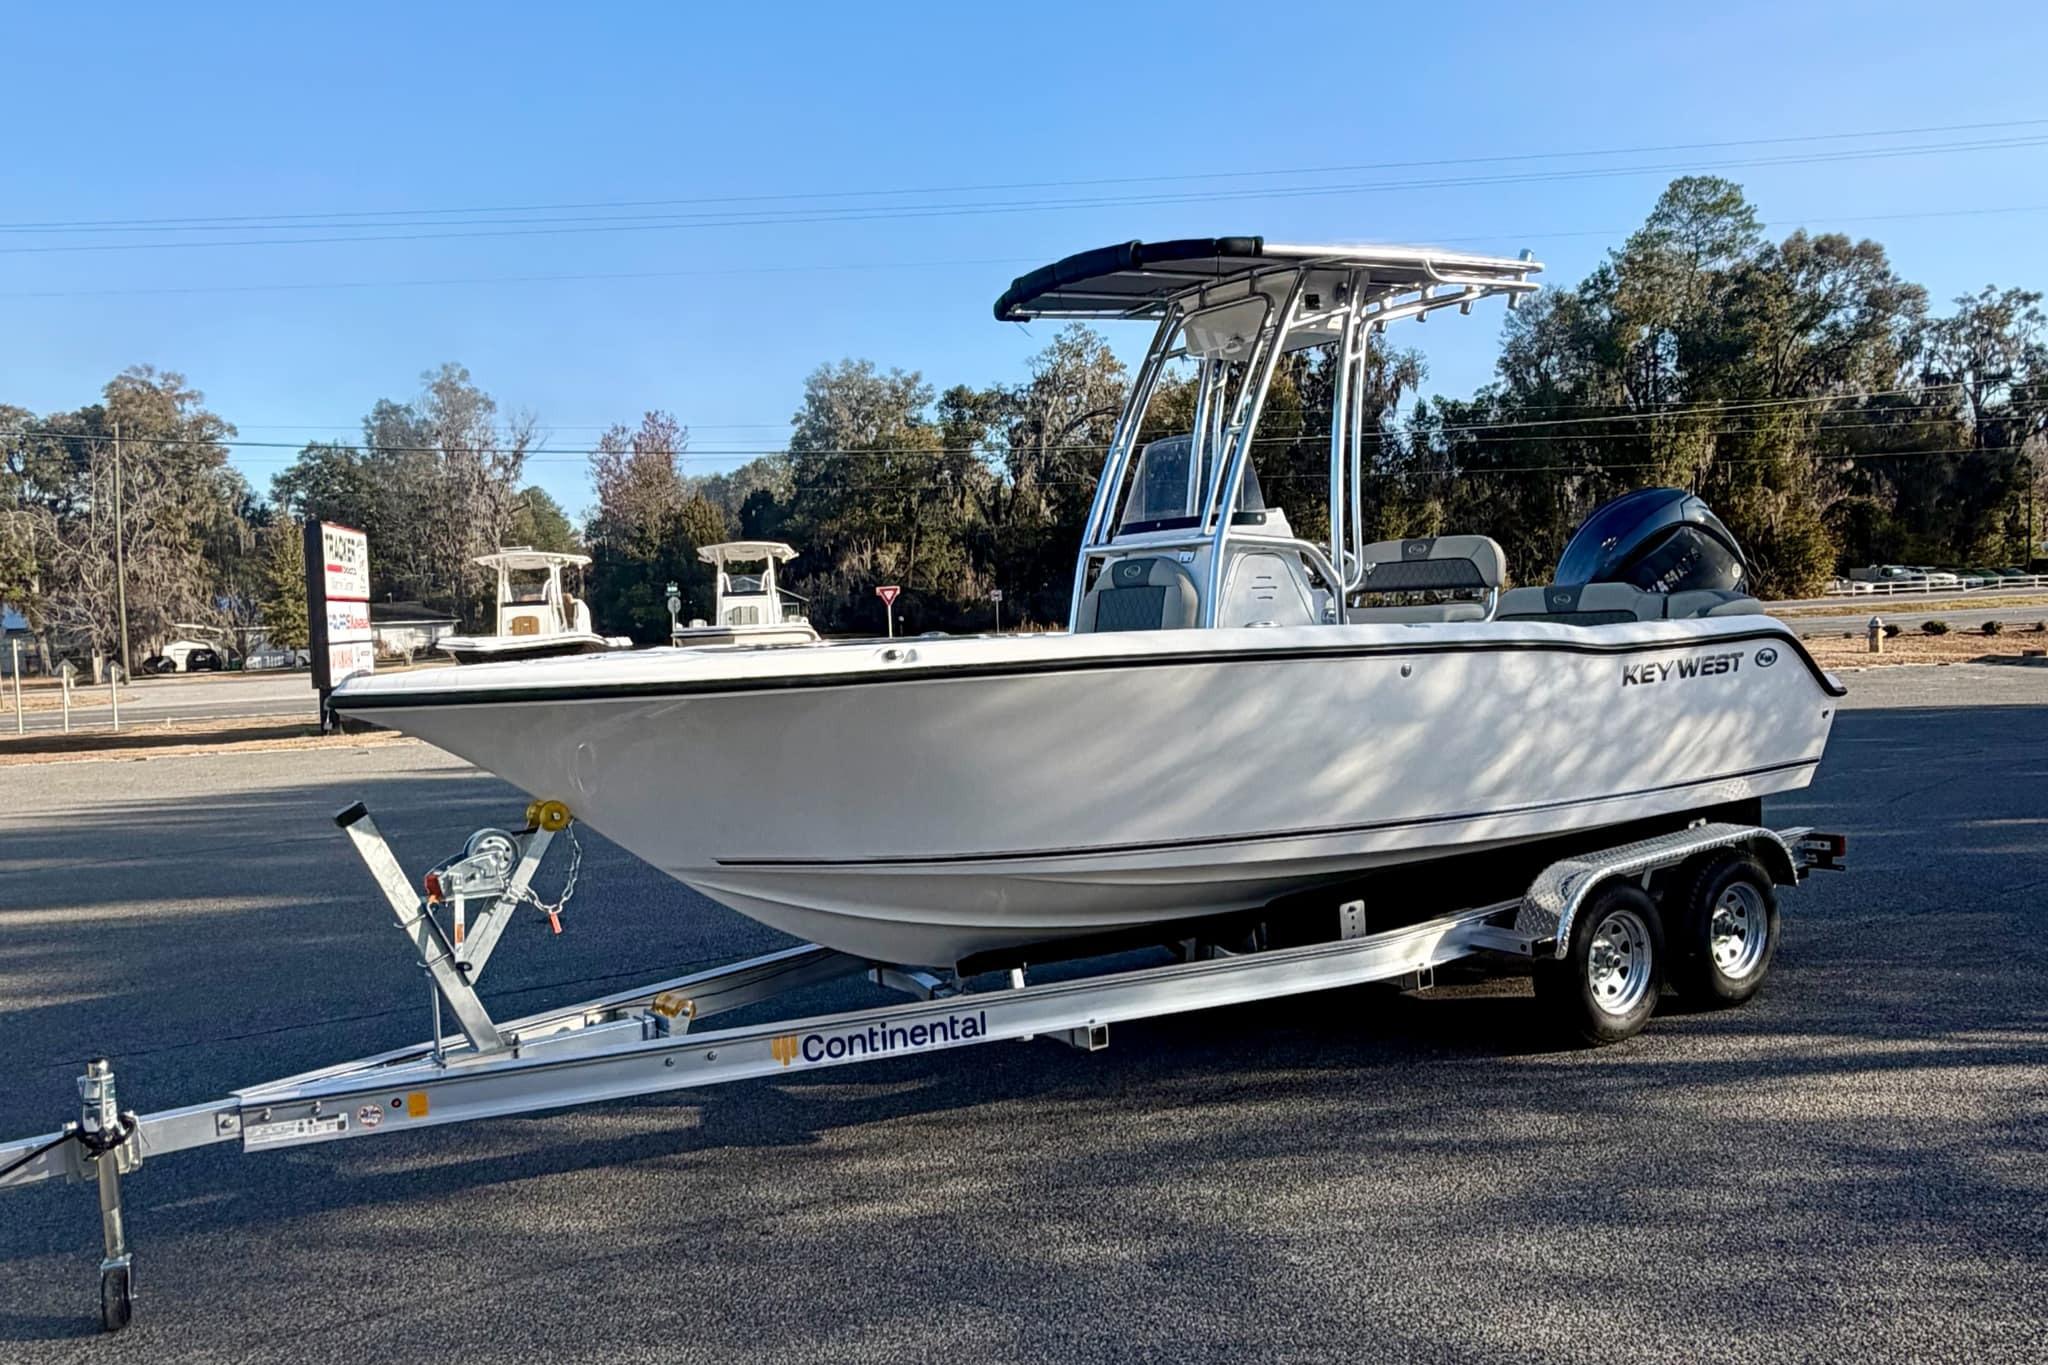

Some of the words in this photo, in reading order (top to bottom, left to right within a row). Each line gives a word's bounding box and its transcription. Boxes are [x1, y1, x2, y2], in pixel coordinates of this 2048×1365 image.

[1622, 659, 1674, 687] KEY
[1677, 651, 1745, 679] WEST
[802, 1010, 987, 1062] Continental
